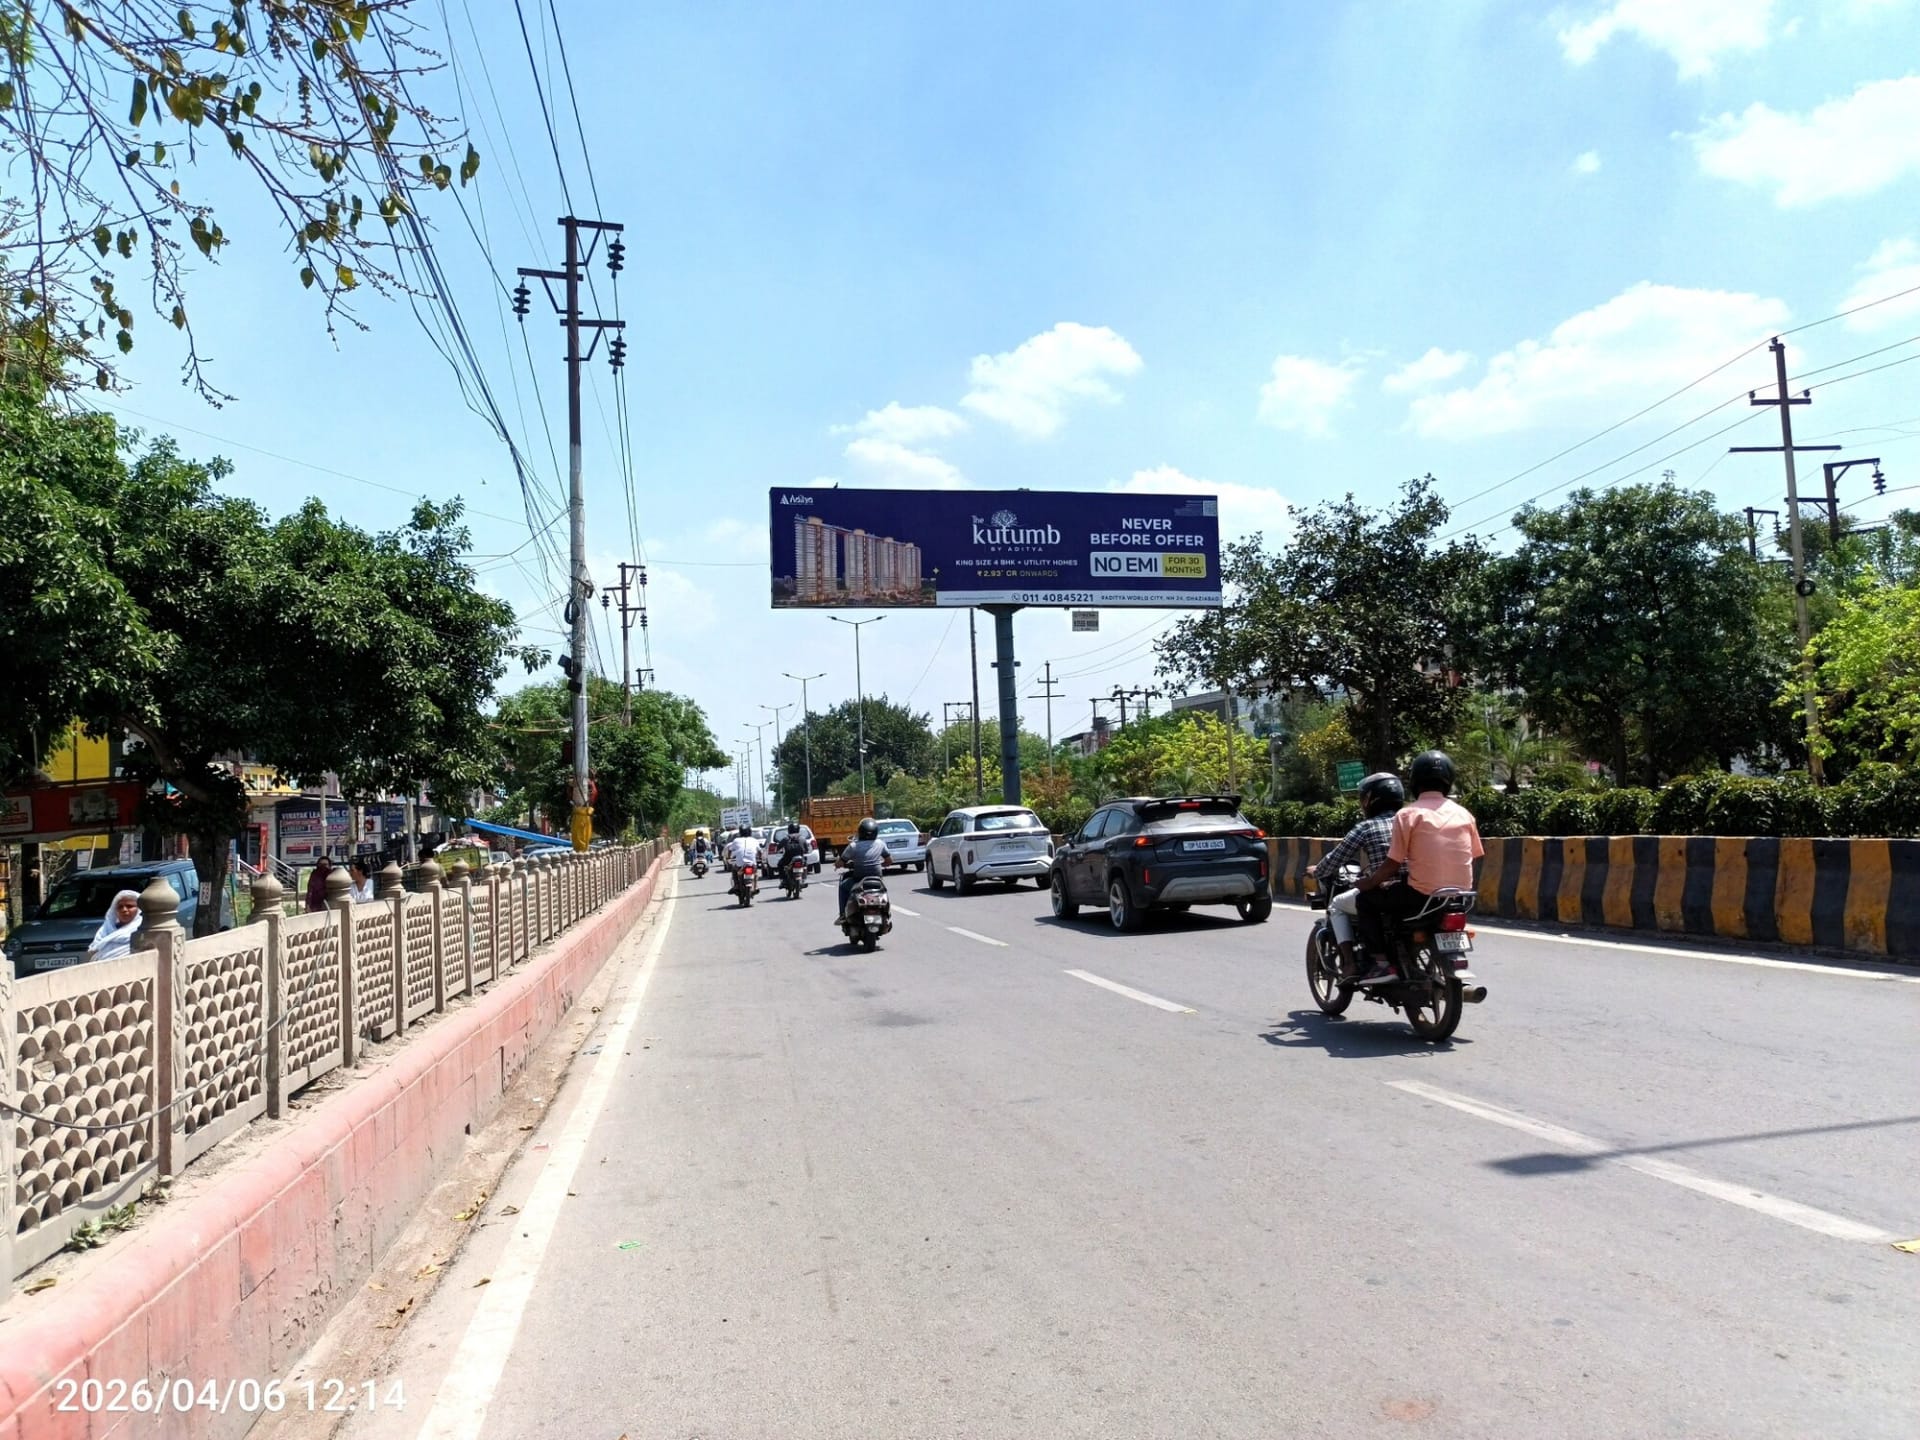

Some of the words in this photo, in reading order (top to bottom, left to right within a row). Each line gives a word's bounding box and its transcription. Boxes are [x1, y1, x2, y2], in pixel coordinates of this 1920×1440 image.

[972, 515, 984, 524] The
[1122, 518, 1172, 530] NEVER
[972, 524, 1061, 545] kutumb
[1090, 533, 1151, 546] BEFORE
[1155, 534, 1204, 546] OFFER
[1052, 559, 1079, 567] HOMES
[1094, 556, 1122, 573] NO
[1126, 556, 1158, 573] EMI
[1168, 556, 1186, 564] FOR
[1188, 557, 1200, 565] 30
[1022, 593, 1039, 602] 011
[1042, 593, 1094, 602] 40845221
